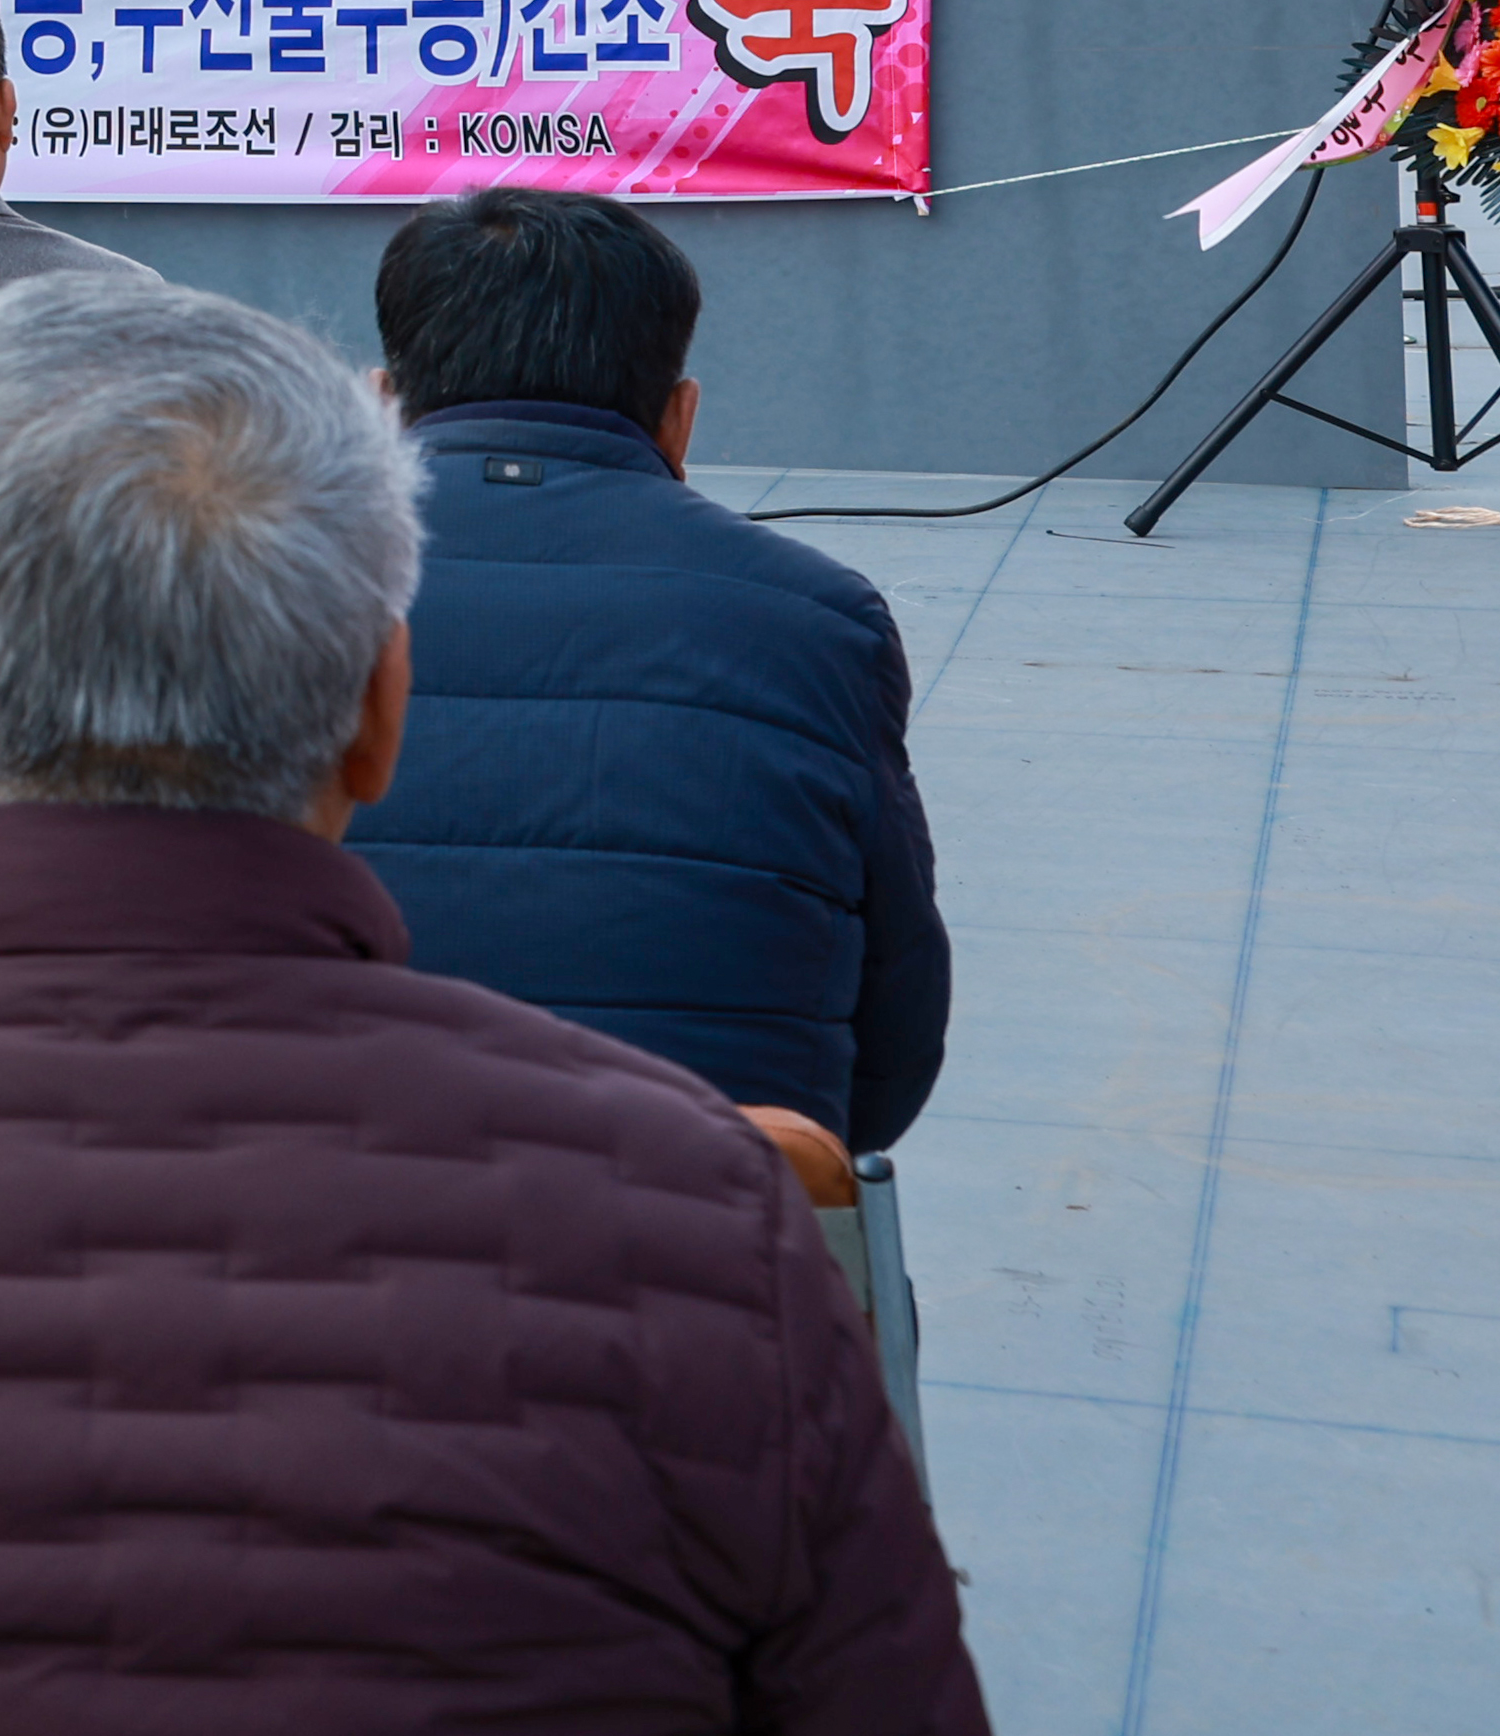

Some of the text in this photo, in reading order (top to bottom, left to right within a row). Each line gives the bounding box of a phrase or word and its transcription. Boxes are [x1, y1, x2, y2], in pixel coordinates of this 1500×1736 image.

[30, 105, 278, 158] (유)미래로조선
[329, 111, 403, 159] 감리
[460, 111, 616, 157] KOMSA
